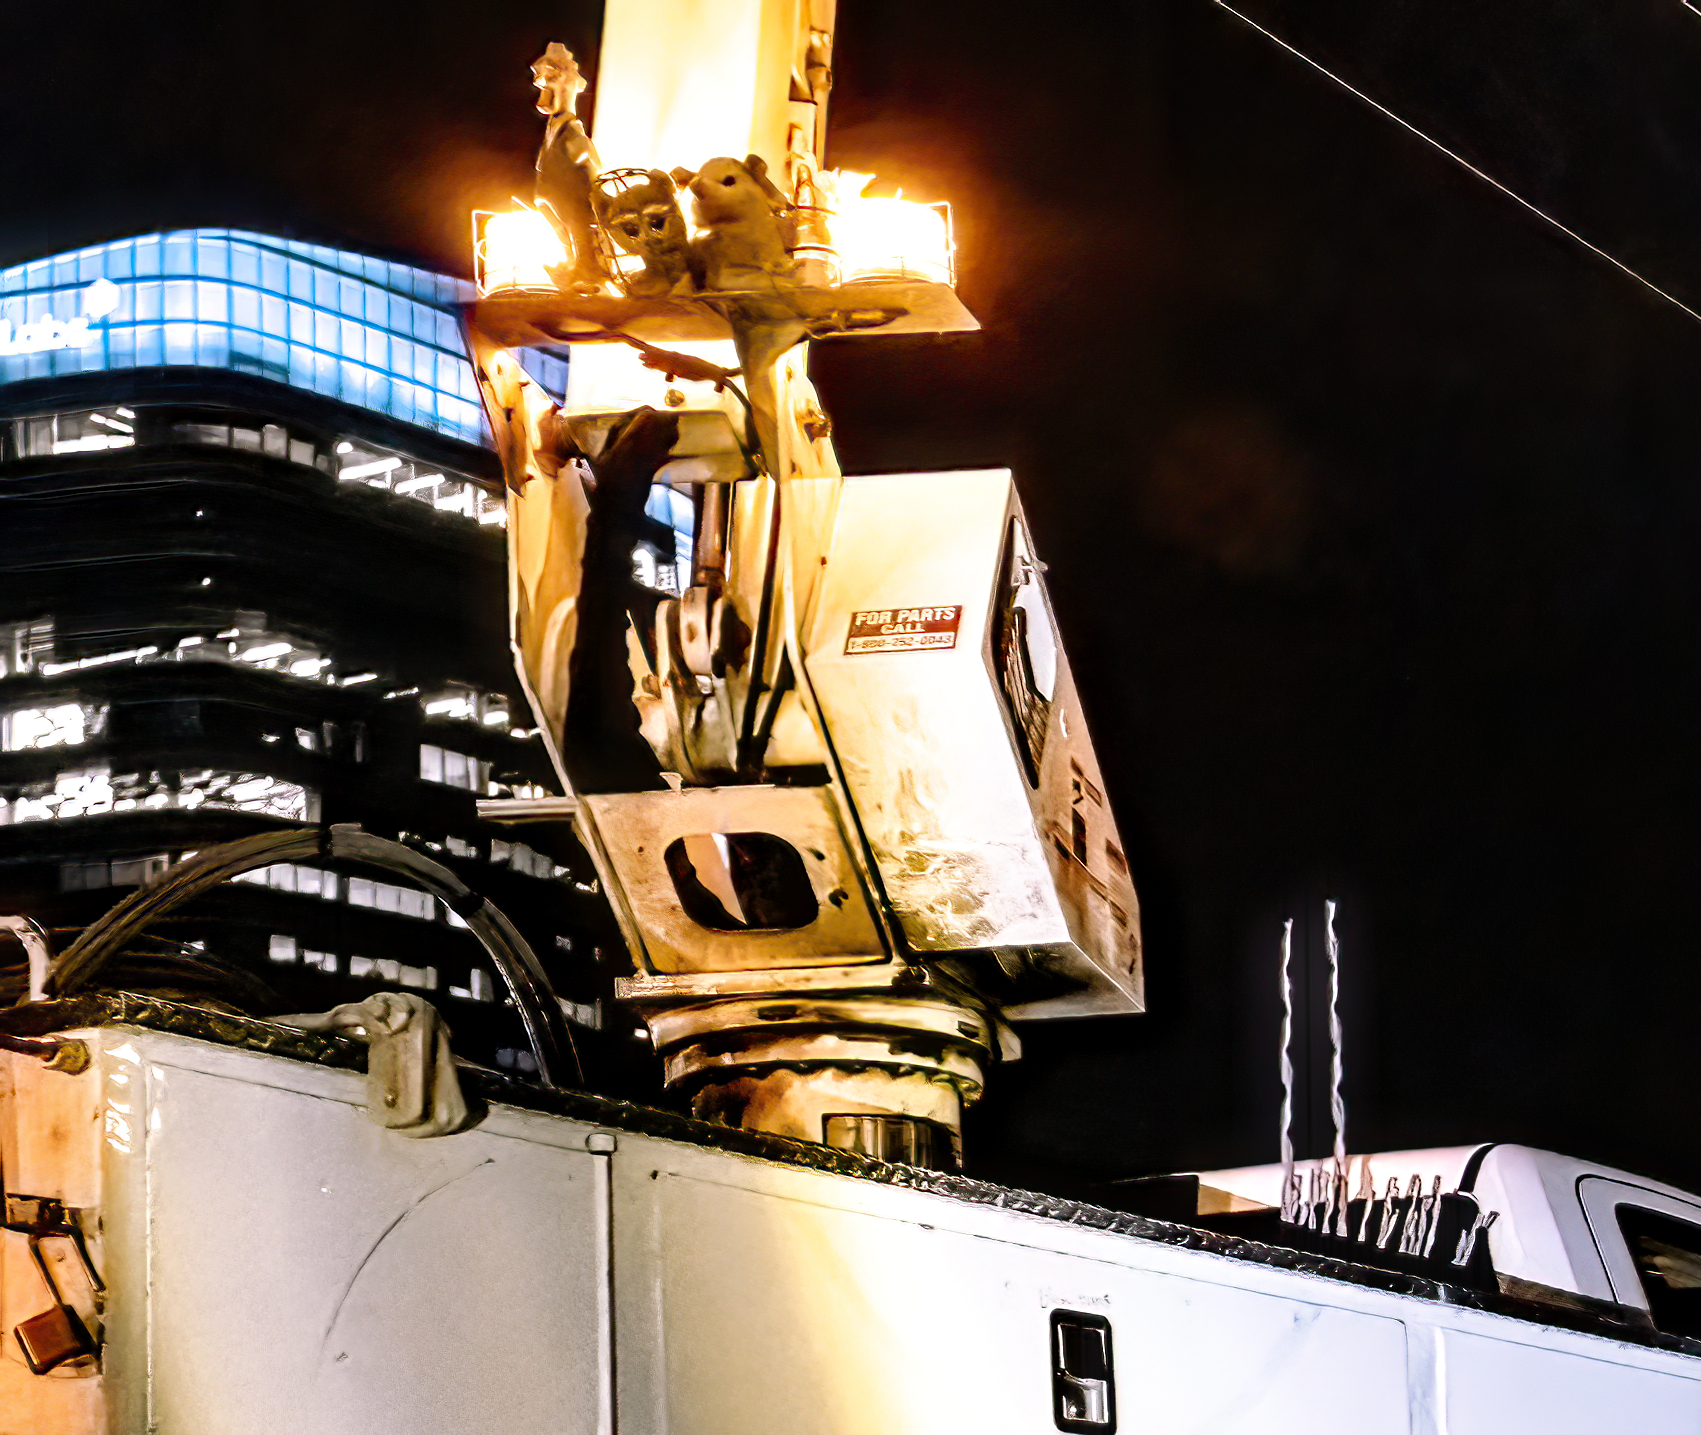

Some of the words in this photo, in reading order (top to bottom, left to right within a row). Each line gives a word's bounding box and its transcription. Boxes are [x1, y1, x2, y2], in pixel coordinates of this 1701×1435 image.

[854, 611, 892, 626] FOR
[897, 606, 956, 623] PARTS
[880, 622, 925, 635] CALL
